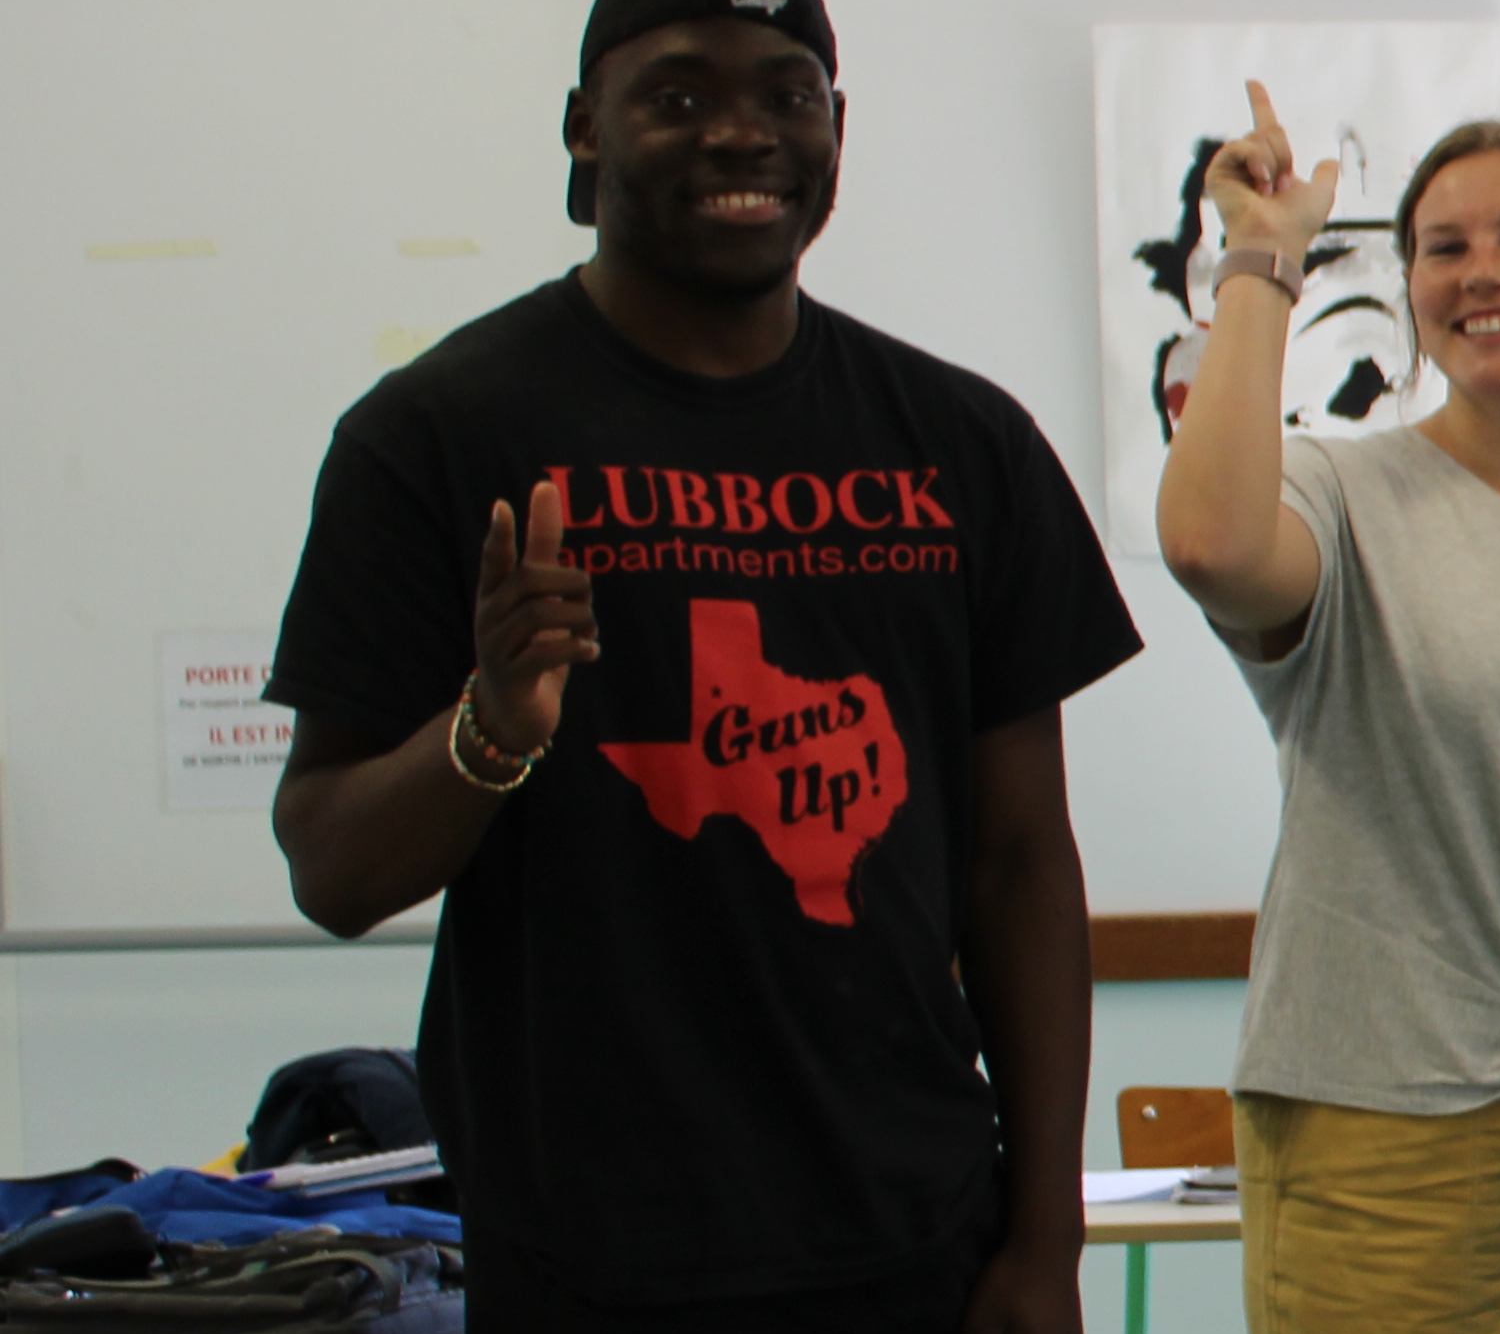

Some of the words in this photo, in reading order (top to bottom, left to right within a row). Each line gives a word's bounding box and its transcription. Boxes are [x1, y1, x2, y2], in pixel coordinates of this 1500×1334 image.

[543, 465, 955, 534] LUBBOCK
[185, 666, 254, 685] PORTE
[209, 727, 225, 744] IL
[233, 726, 267, 744] EST
[703, 687, 866, 766] Guns
[776, 741, 881, 833] Up!
